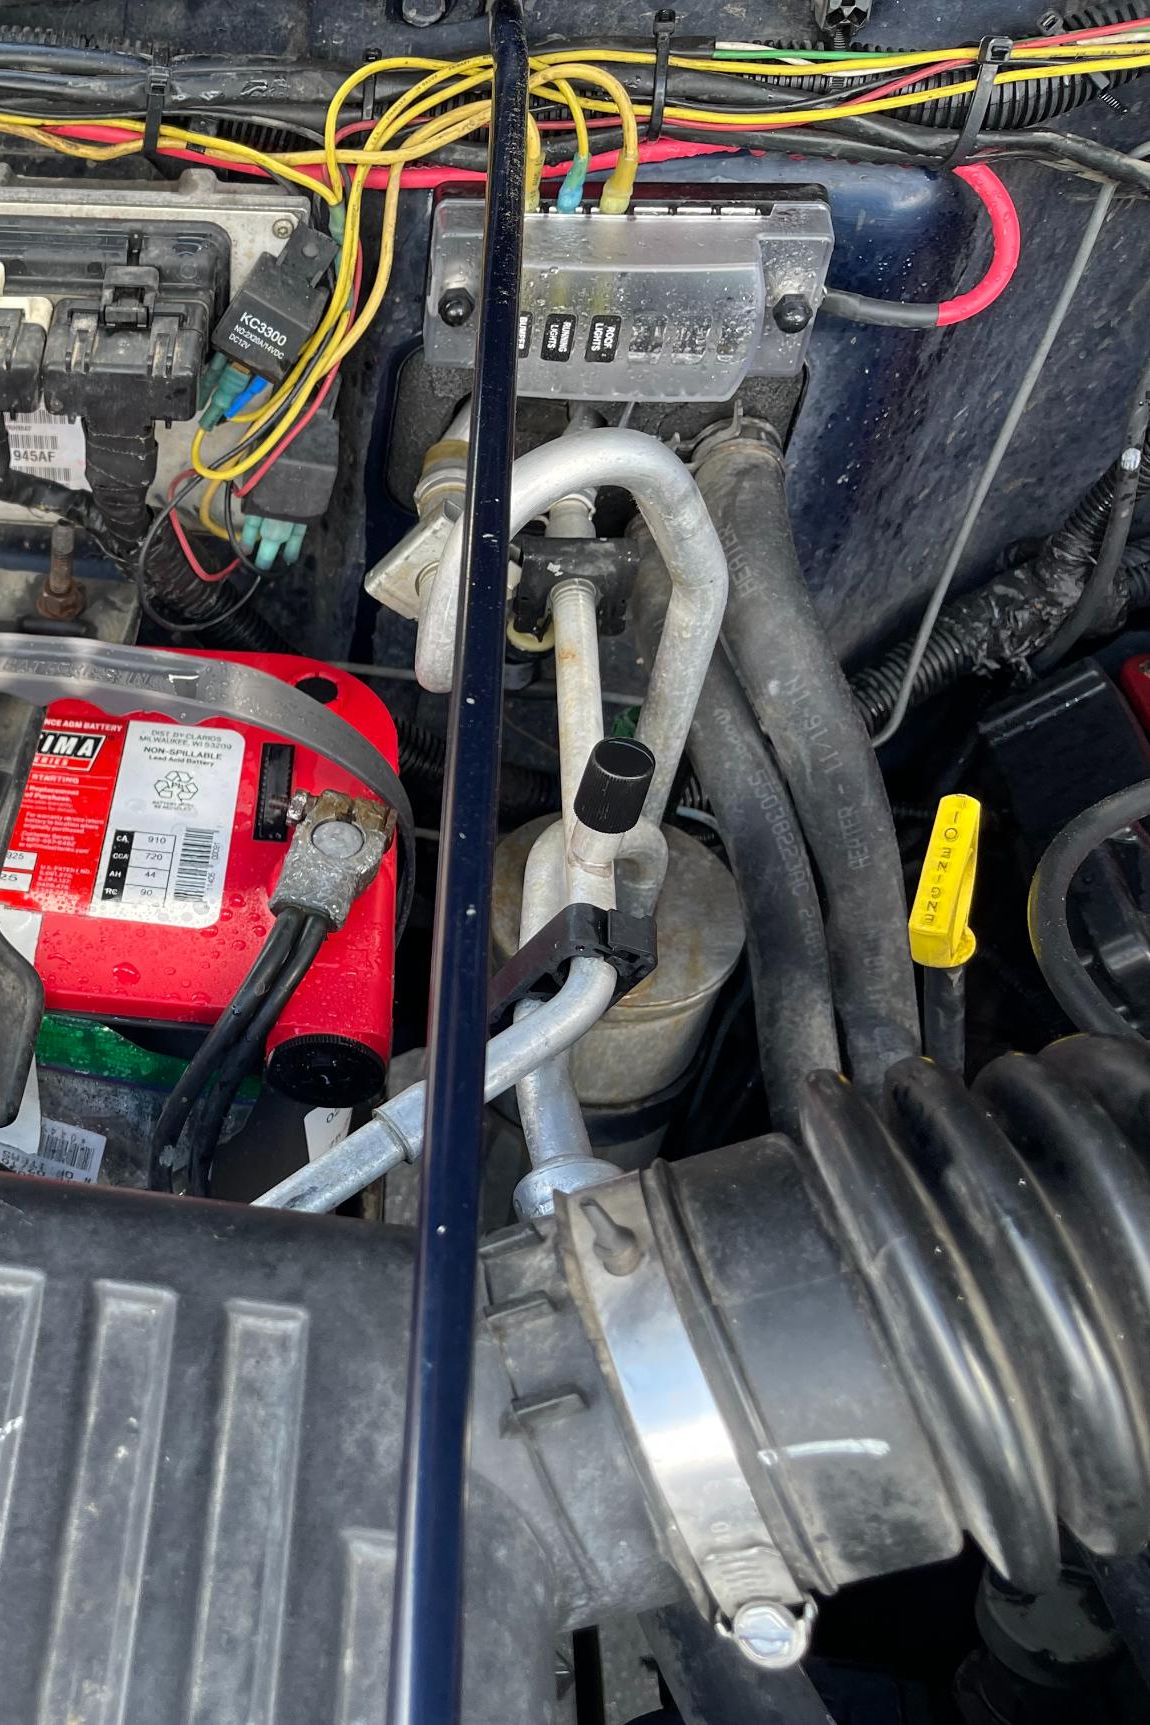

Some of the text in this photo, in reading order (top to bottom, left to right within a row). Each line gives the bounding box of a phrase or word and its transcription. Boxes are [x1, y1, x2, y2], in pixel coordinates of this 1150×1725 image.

[240, 311, 287, 347] KC3300
[228, 333, 251, 350] DC12V
[547, 323, 558, 350] LIGHTS
[558, 321, 571, 353] RUNNING
[591, 322, 603, 352] LIGHTS
[602, 325, 616, 350] ROOF
[13, 450, 56, 462] 945AF
[83, 721, 123, 732] BATTERY
[40, 734, 95, 758] IMA
[143, 746, 222, 760] NON-SPILLABLE
[34, 755, 69, 767] ERIES
[186, 758, 214, 768] Battery
[31, 774, 80, 785] STARTING
[171, 781, 184, 791] Pb
[148, 836, 166, 844] 910
[748, 769, 810, 897] 55038223AC
[837, 804, 872, 871] HEATER
[112, 852, 163, 861] CCA 720
[109, 870, 122, 878] AH
[140, 888, 153, 896] 90
[924, 848, 952, 924] ENGINE
